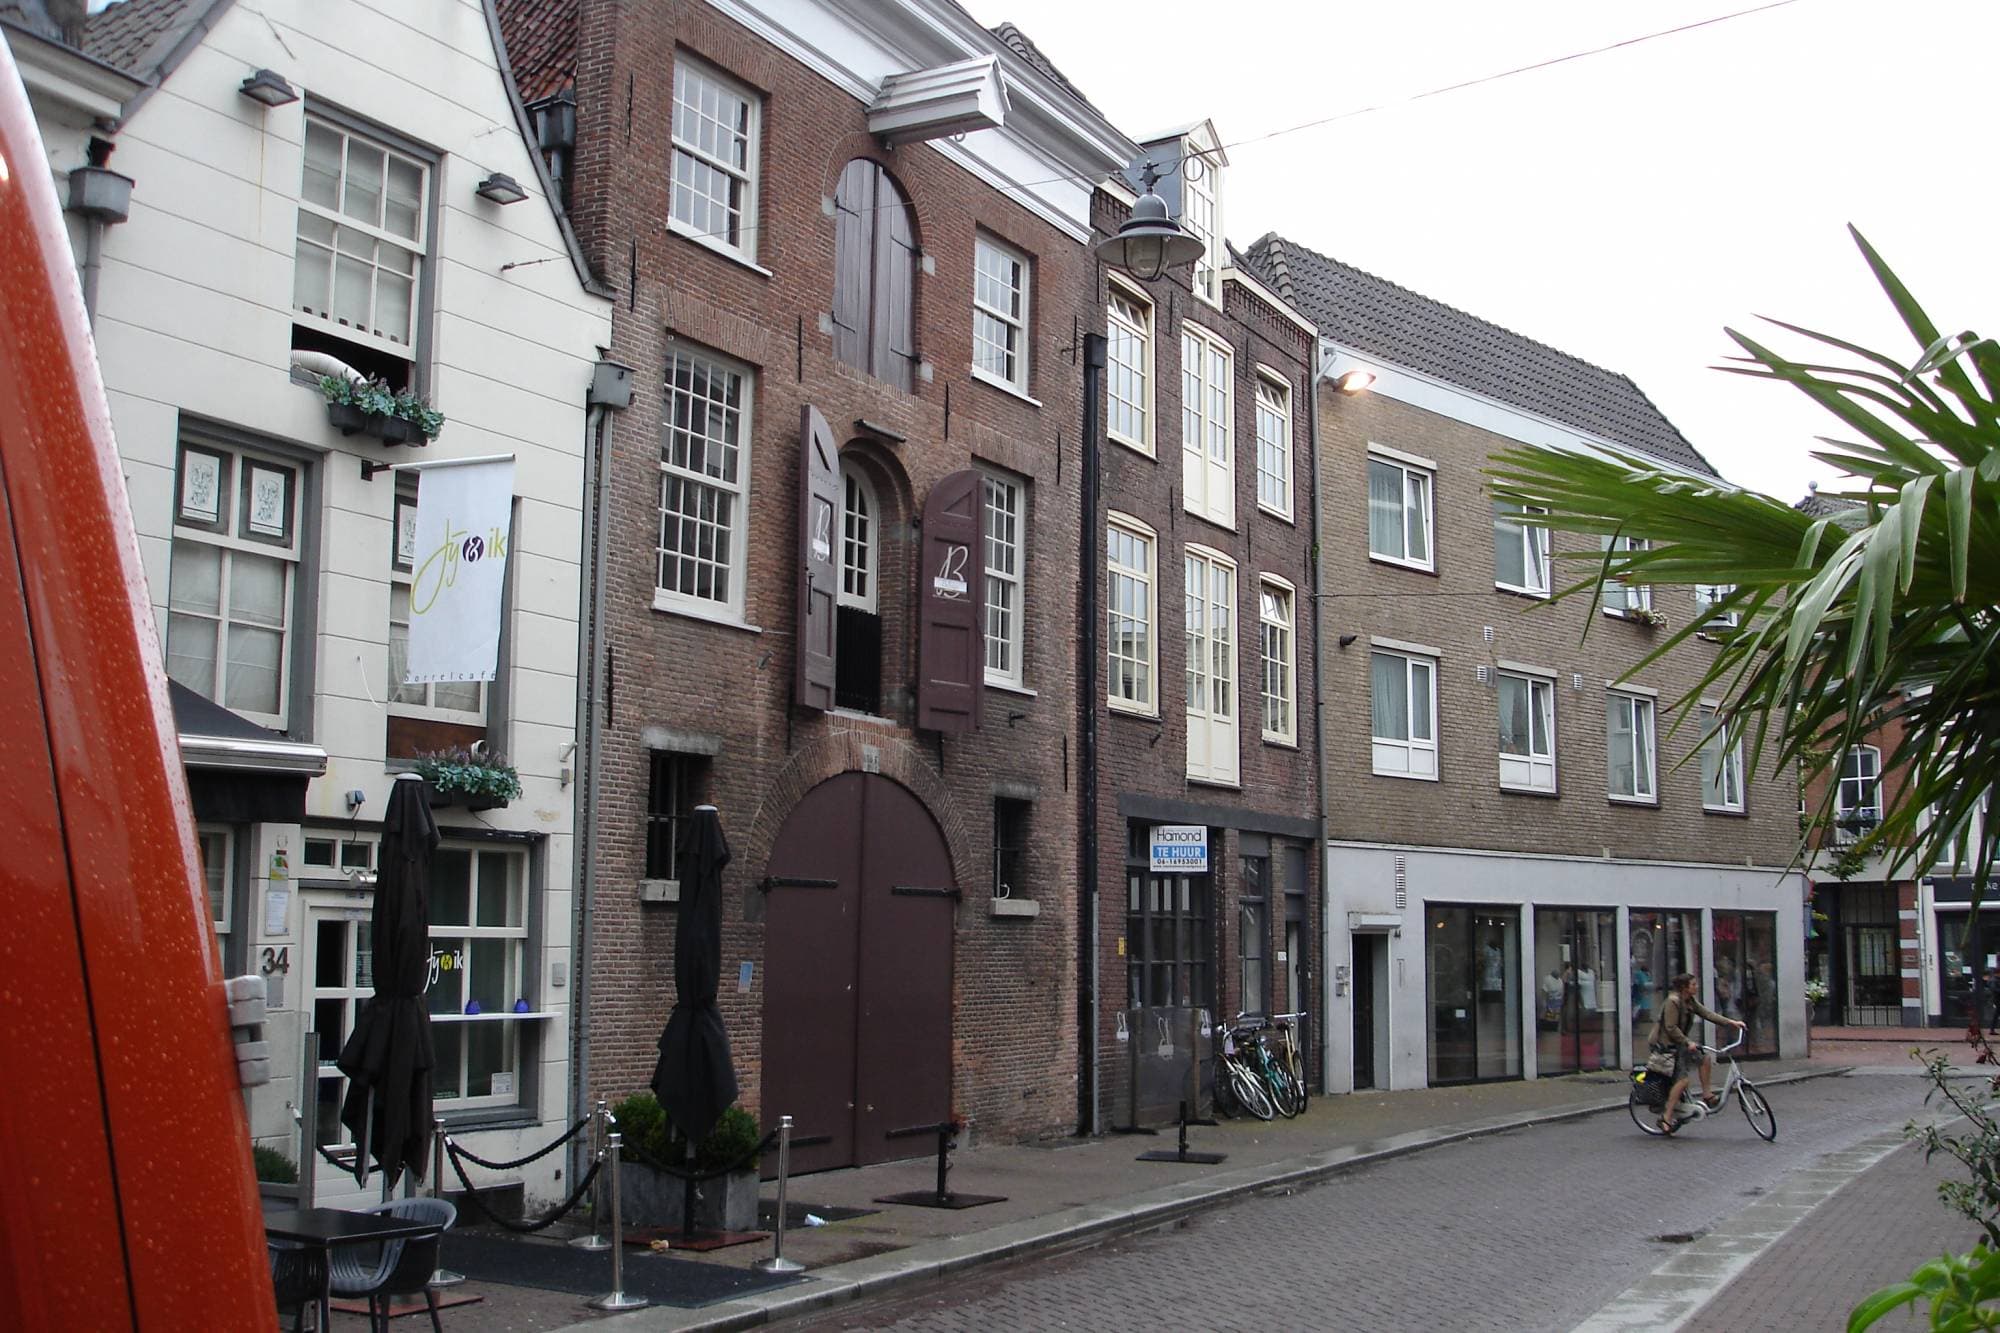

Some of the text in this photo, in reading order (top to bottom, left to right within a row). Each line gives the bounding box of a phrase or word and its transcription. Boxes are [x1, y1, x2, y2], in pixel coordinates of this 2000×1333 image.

[488, 527, 506, 558] ik
[1156, 827, 1202, 842] Hamond
[1157, 846, 1202, 857] TE HUUR
[262, 947, 290, 974] 34
